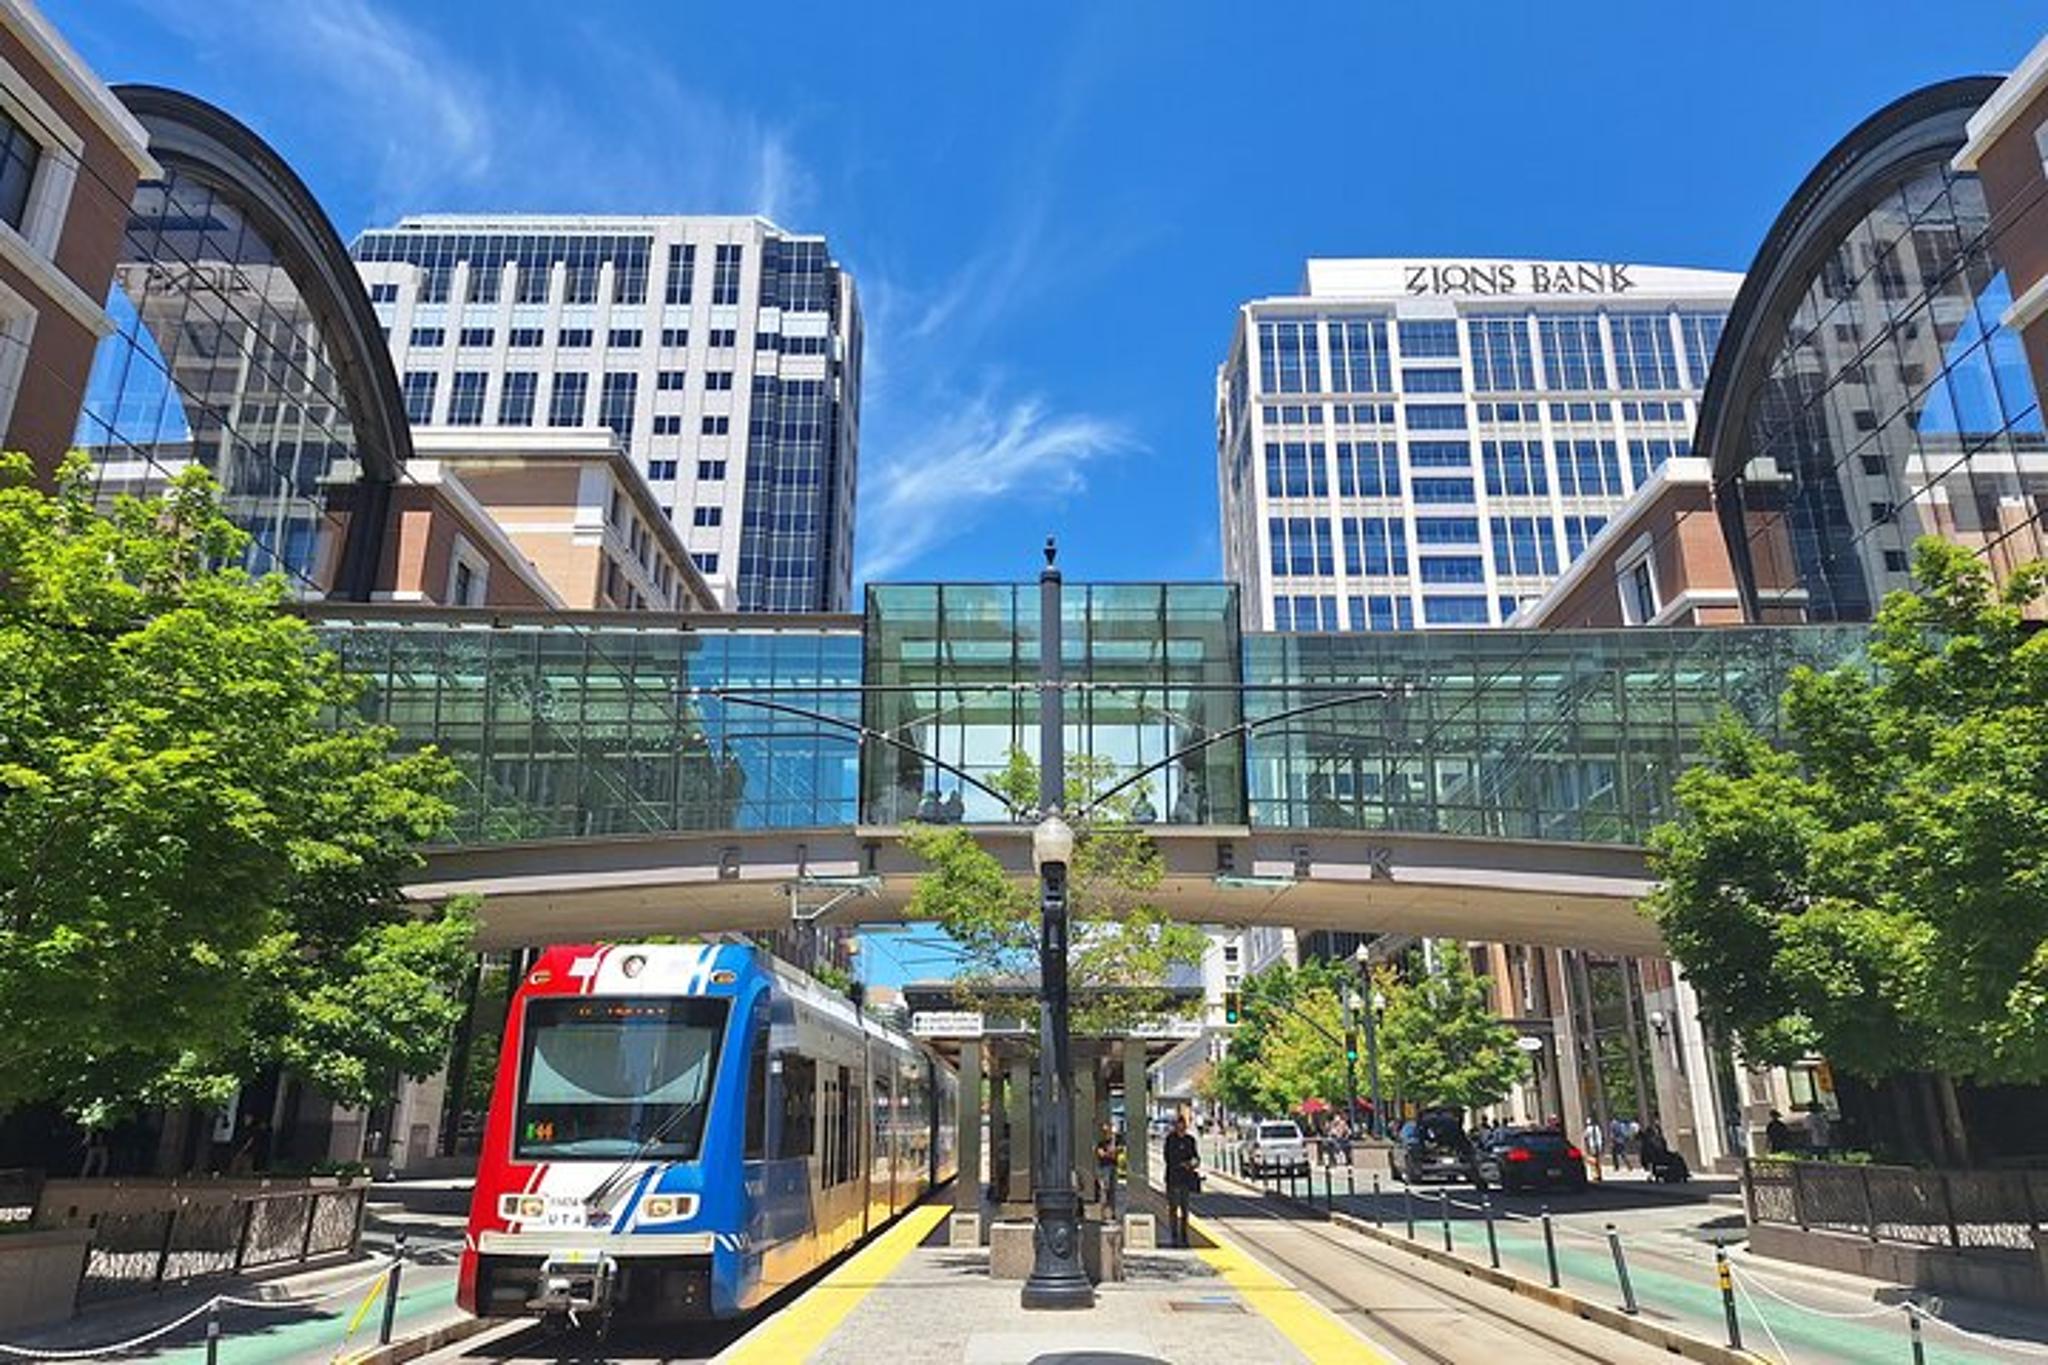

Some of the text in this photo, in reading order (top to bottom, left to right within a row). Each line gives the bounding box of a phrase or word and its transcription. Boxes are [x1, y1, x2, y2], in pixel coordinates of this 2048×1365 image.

[1404, 263, 1636, 294] ZIONS BANK
[719, 843, 884, 880] CIT
